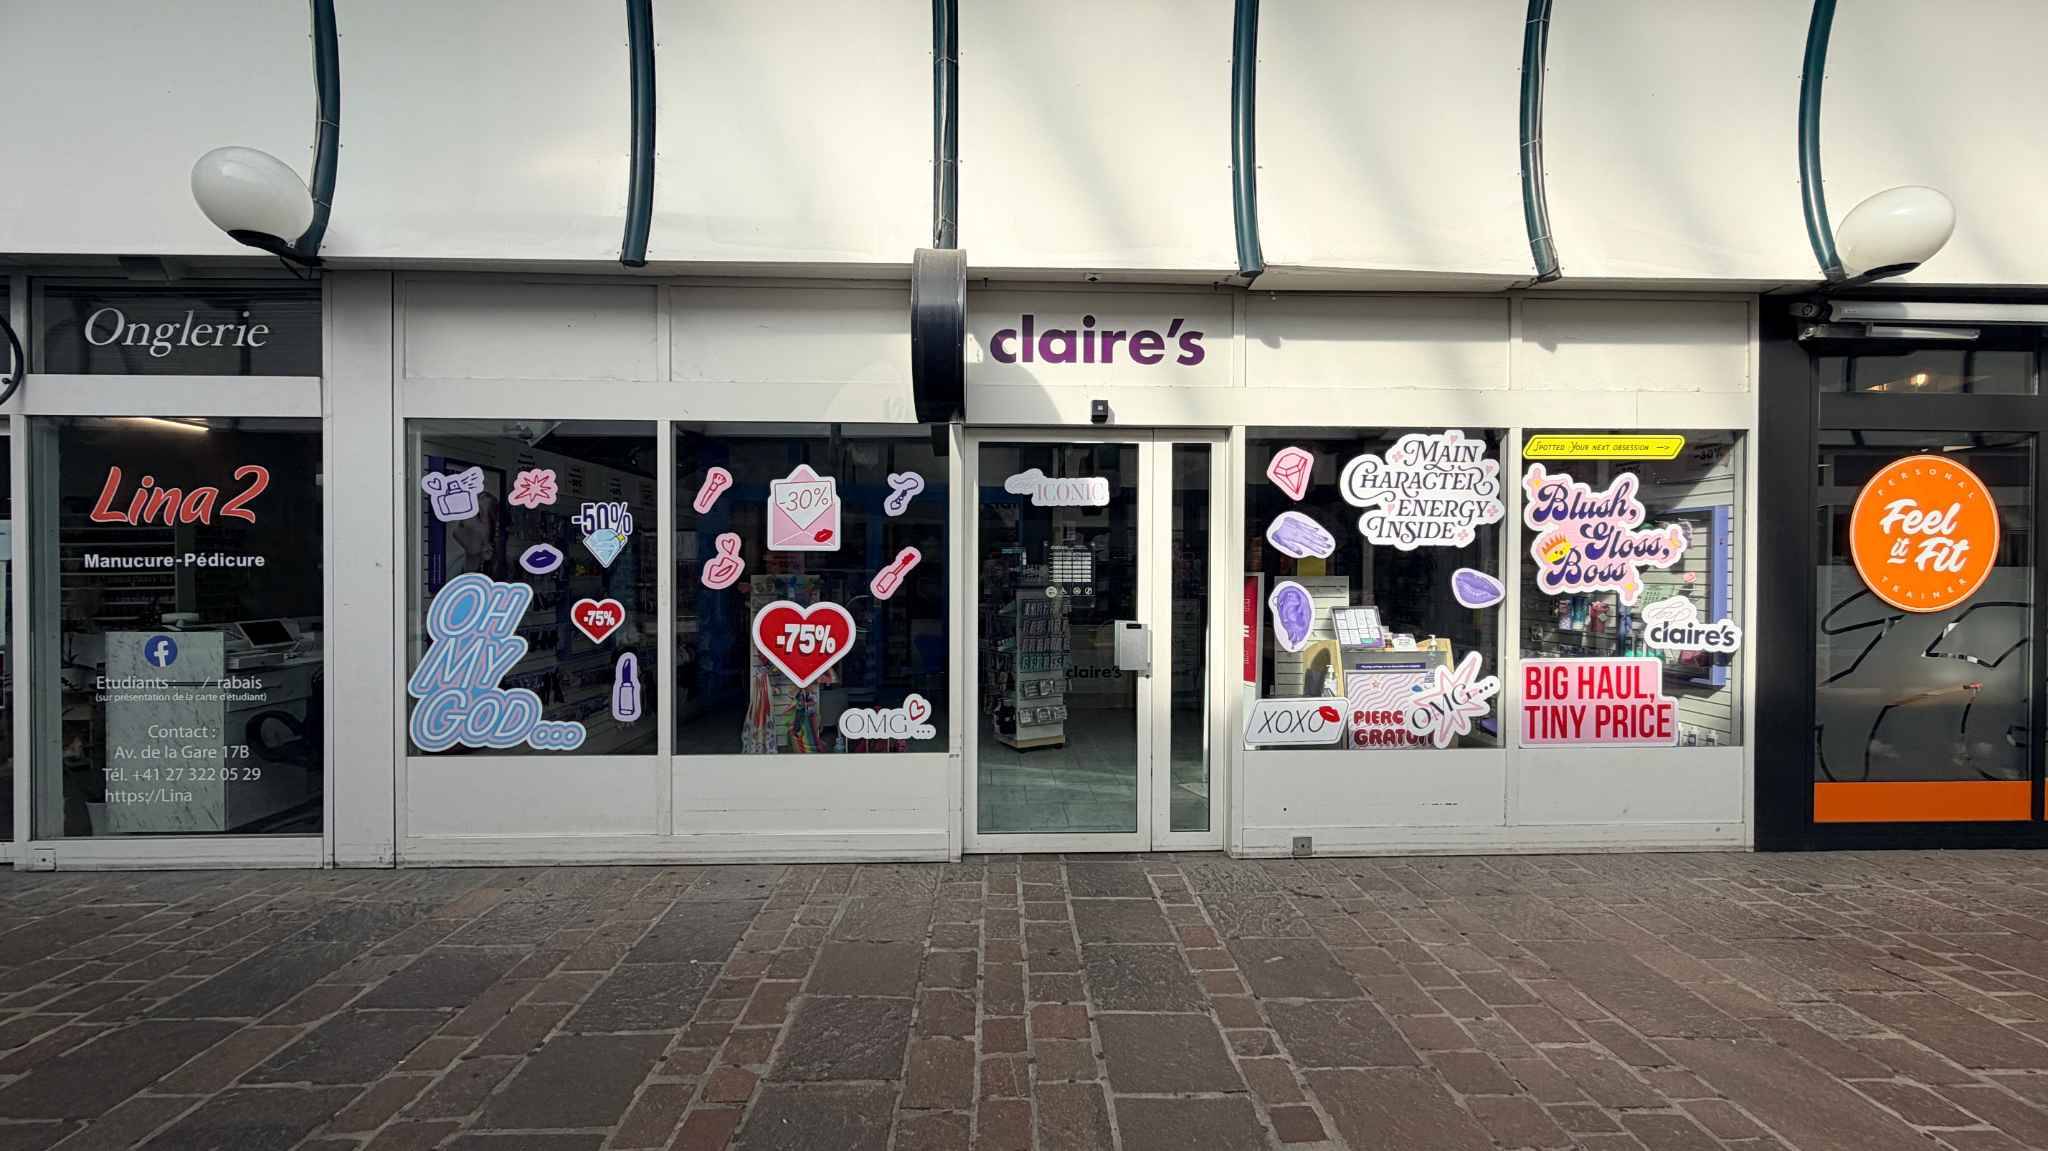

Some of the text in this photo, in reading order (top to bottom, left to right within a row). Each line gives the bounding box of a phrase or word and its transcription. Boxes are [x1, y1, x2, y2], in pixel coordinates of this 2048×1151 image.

[84, 307, 270, 357] Onglerie
[990, 314, 1206, 366] claire's
[1403, 440, 1479, 472] MAIN
[1592, 443, 1610, 451] NEXT
[1348, 460, 1493, 503] CHARACTER
[1878, 468, 1974, 498] PERSONAL
[780, 486, 829, 512] -30%
[1396, 500, 1490, 526] ENERGY
[1532, 481, 1637, 523] Blush,
[572, 503, 632, 534] -50%
[1366, 516, 1455, 544] INSIDE
[1880, 498, 1961, 535] Feel
[1580, 522, 1670, 562] Gloss,
[1888, 537, 1970, 573] it Fit
[84, 553, 265, 569] Manucure-Pédicure
[1546, 547, 1627, 586] Boss
[1881, 575, 1968, 600] TRAINER
[432, 578, 528, 636] OH
[583, 610, 615, 626] -75%
[776, 623, 836, 655] -75%
[1650, 620, 1735, 647] claire's
[414, 636, 524, 694] MY
[1064, 664, 1123, 680] claire's
[217, 675, 263, 690] rabais
[1525, 665, 1656, 703] BIG HAUL,
[195, 693, 217, 701] carte
[1257, 710, 1328, 734] XOXO
[1353, 710, 1406, 724] PIERC
[1524, 703, 1672, 739] TINY PRICE
[148, 724, 208, 739] Contact
[114, 745, 250, 759] Av. de la Gare 17B
[103, 767, 261, 781] Tél. +41 27 322 05 29
[105, 788, 193, 805] https://Lina
